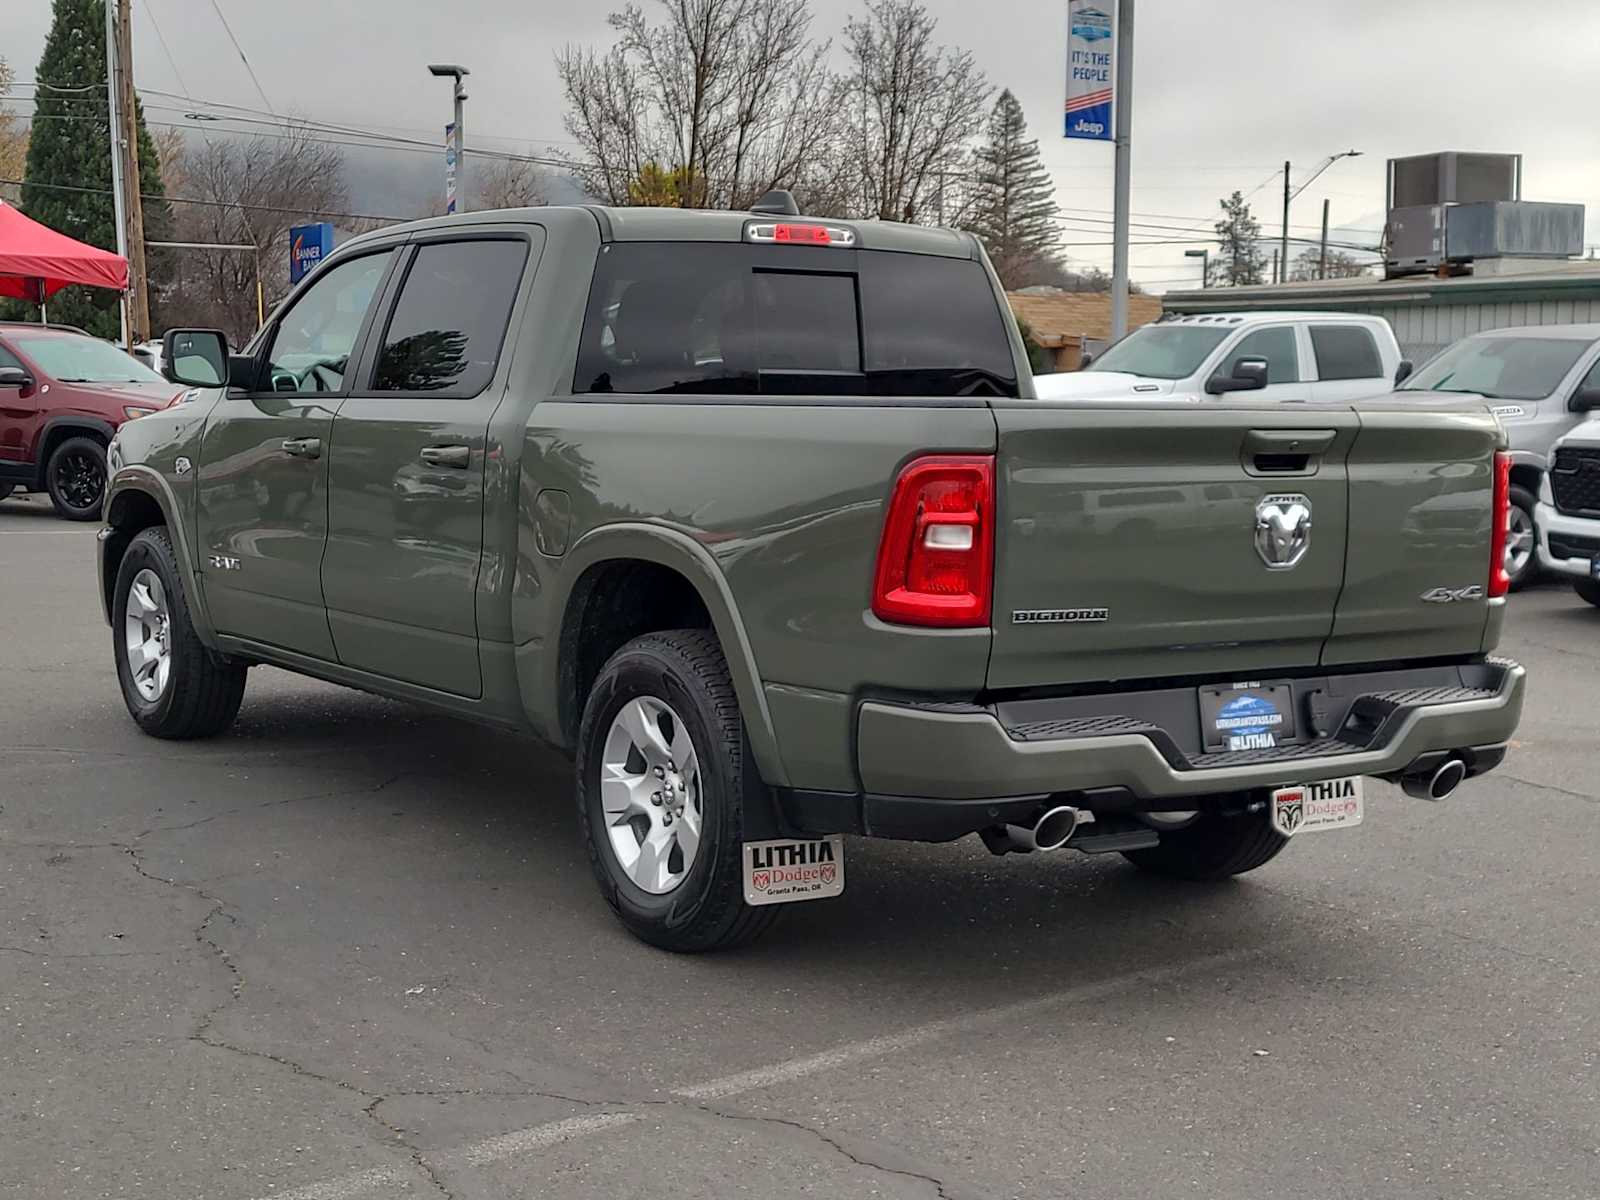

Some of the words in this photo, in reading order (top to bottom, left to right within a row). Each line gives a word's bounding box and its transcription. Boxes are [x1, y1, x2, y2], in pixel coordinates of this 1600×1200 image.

[1072, 51, 1089, 64] IT'S
[1091, 52, 1111, 65] THE
[1073, 67, 1109, 81] PEOPLE
[1074, 119, 1105, 135] Jeep
[296, 246, 320, 260] BANNER
[1240, 733, 1276, 749] LITHIA
[1307, 780, 1355, 801] THIA
[1307, 802, 1343, 816] Dodge
[752, 841, 834, 869] LITHIA
[773, 867, 818, 884] Dodge
[767, 886, 790, 895] Grants
